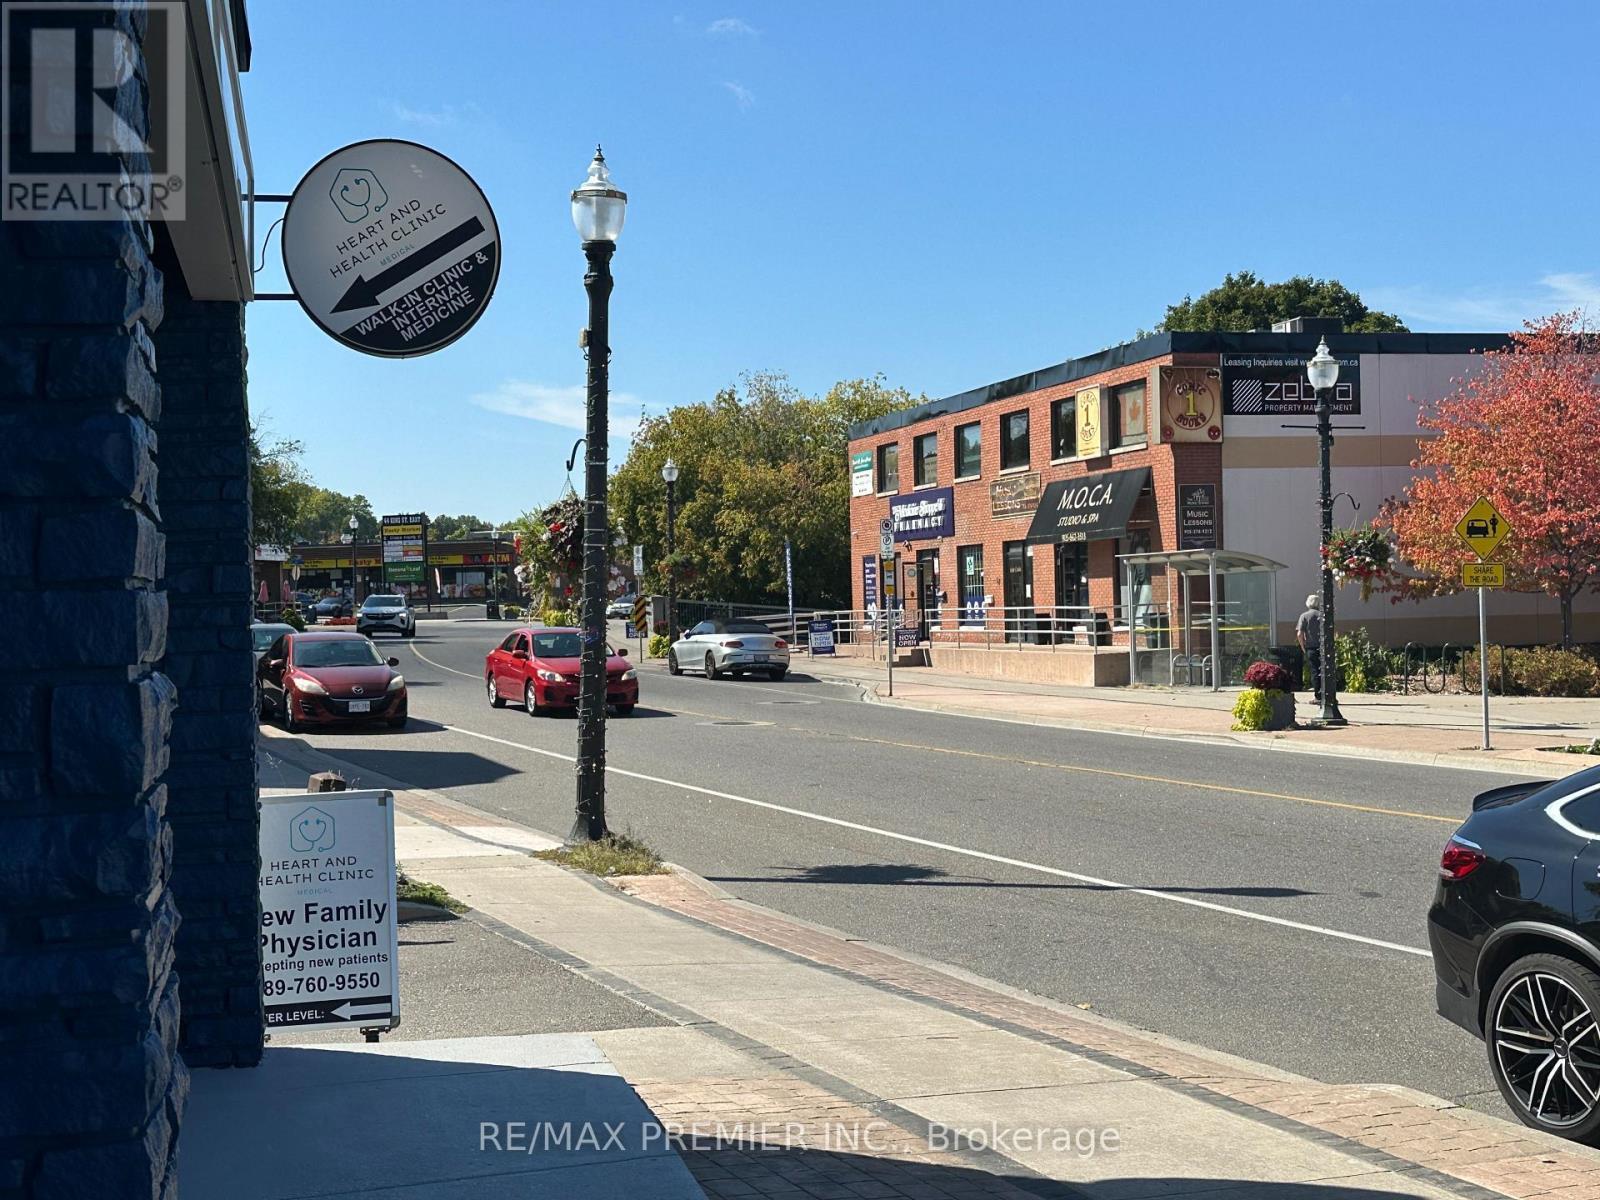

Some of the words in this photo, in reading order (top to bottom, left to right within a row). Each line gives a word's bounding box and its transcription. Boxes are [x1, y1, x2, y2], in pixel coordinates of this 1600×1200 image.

[336, 219, 385, 255] HEART
[390, 199, 421, 225] AND
[329, 240, 388, 278] HEALTH
[391, 203, 447, 242] CLINIC
[380, 244, 415, 266] MEDICAL
[355, 290, 422, 336] WALK-IN
[422, 259, 473, 296] CLINIC
[475, 251, 488, 264] &
[391, 281, 470, 331] INTERNAL
[400, 290, 475, 342] MEDICINE
[1224, 357, 1252, 368] Leasing
[1253, 358, 1283, 369] Inquiries
[1284, 358, 1298, 366] visit
[1176, 382, 1206, 396] COMIC
[1264, 375, 1353, 401] zeba
[1186, 390, 1198, 416] 1
[1265, 404, 1301, 412] PROPERTY
[1056, 482, 1113, 511] M.O.C.A.
[1057, 515, 1082, 527] STUDIO
[1087, 513, 1099, 524] SPA
[1473, 566, 1495, 574] SHARE
[270, 858, 319, 871] HEART
[325, 855, 357, 867] AND
[318, 869, 374, 882] CLINIC
[262, 909, 295, 927] ew
[304, 899, 388, 924] Family
[263, 960, 305, 973] epting
[309, 957, 334, 968] new
[338, 953, 389, 968] patients
[263, 972, 380, 997] 89-760-9550
[265, 1013, 283, 1023] ER
[286, 1009, 325, 1021] LEVEL:
